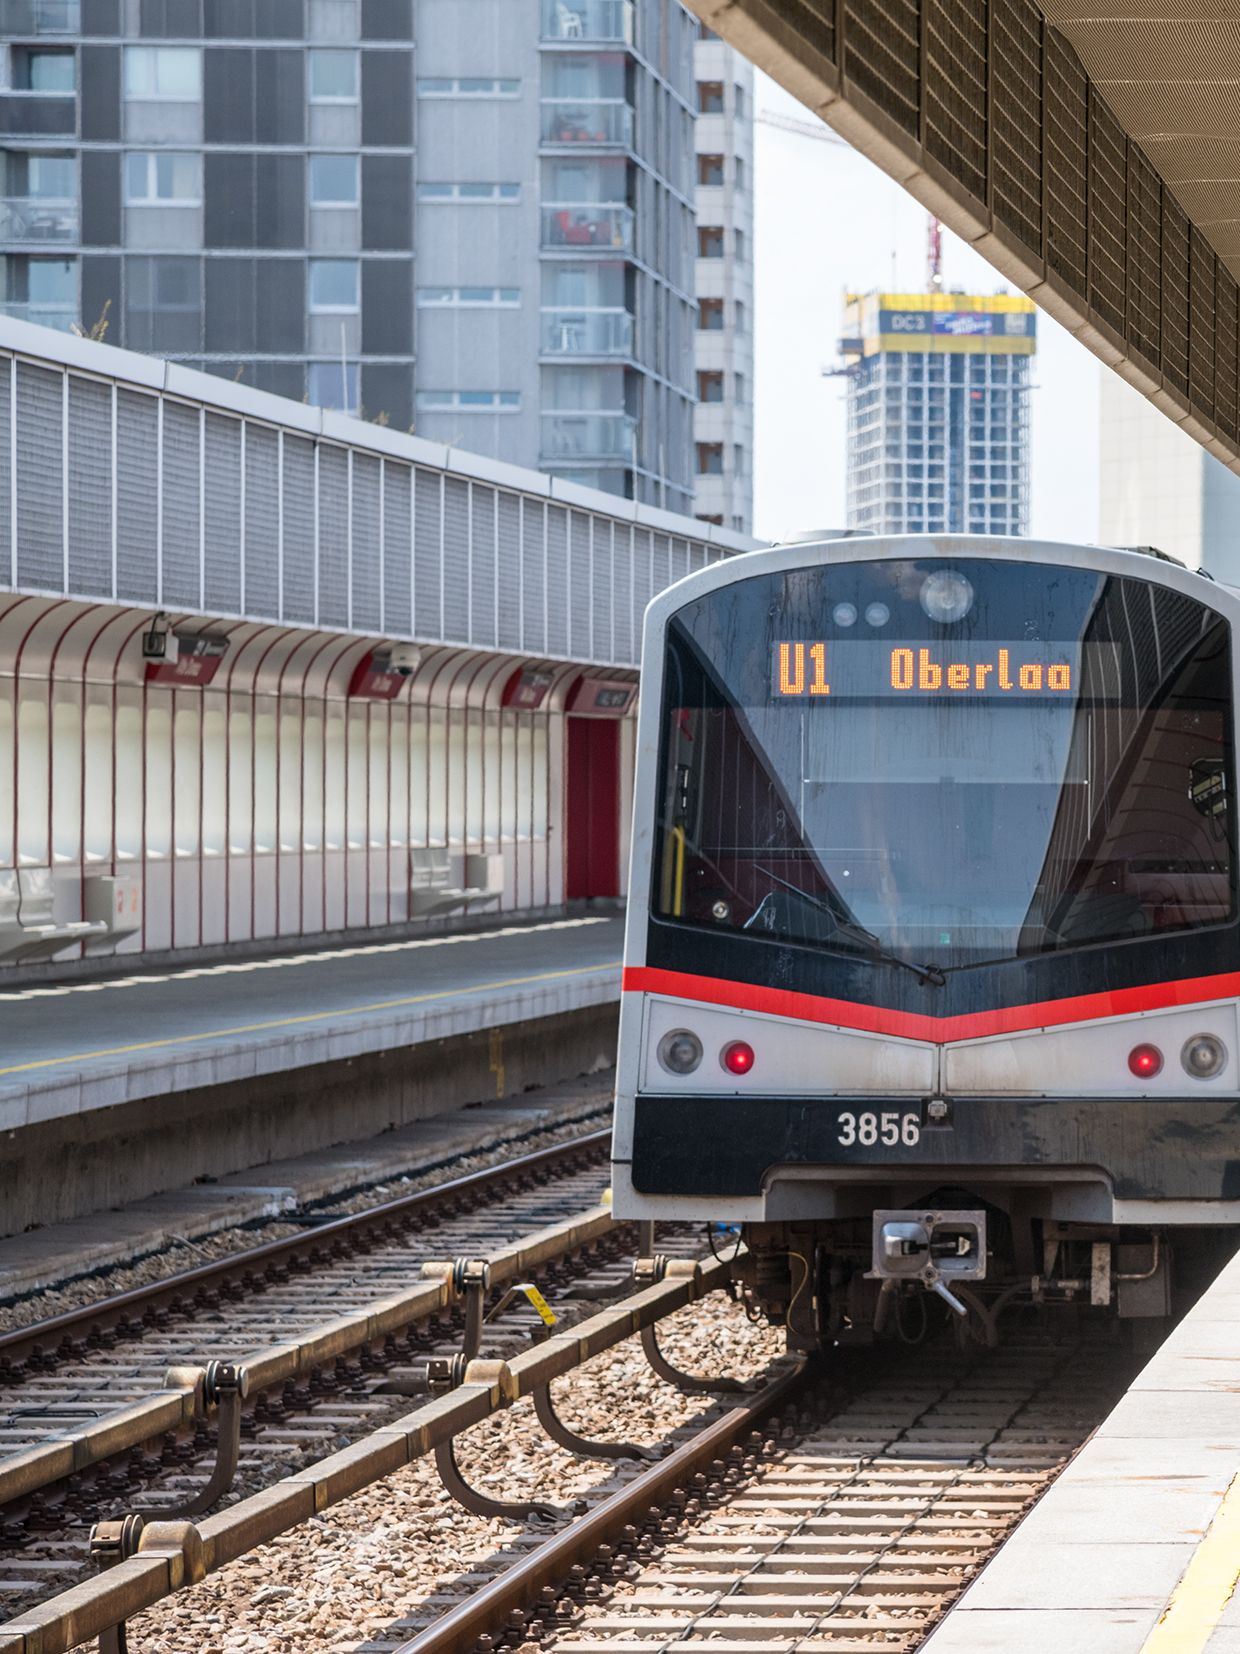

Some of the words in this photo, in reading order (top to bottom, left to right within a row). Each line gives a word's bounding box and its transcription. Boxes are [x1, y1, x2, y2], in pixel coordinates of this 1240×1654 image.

[779, 643, 830, 694] U1
[890, 648, 1070, 690] Oberlaa
[837, 1111, 921, 1147] 3856
